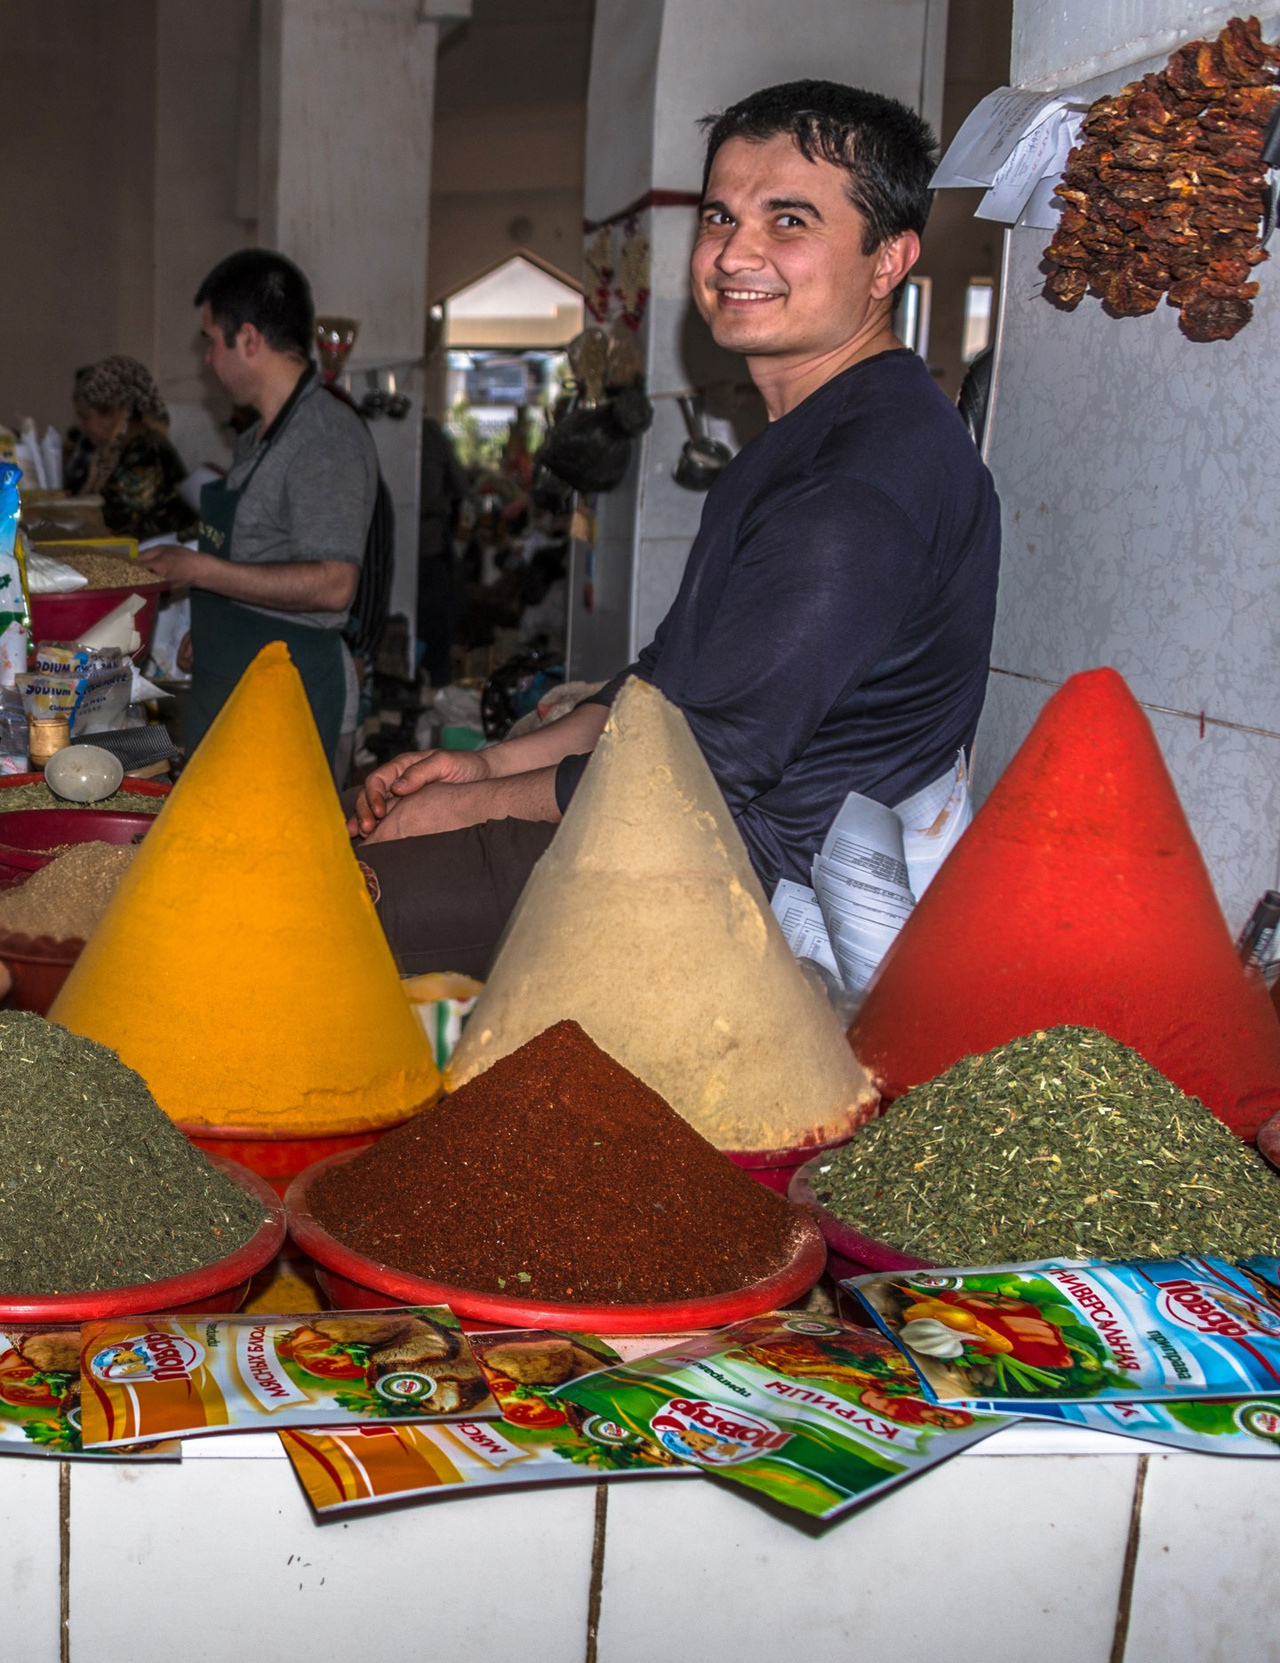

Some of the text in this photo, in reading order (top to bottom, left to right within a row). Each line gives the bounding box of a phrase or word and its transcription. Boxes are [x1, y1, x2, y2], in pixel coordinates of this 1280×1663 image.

[36, 660, 71, 673] ODIUM
[1050, 1268, 1141, 1371] НИВЕРСАЛЬНАЯ
[1154, 1278, 1248, 1337] Повар
[144, 1332, 192, 1382] Повар
[247, 1325, 290, 1397] МЯСНЫХ БЛЮД
[692, 1361, 752, 1397] приправа
[1146, 1330, 1192, 1381] приправа
[669, 1398, 796, 1450] Повар
[765, 1380, 901, 1440] КУРИЦЫ
